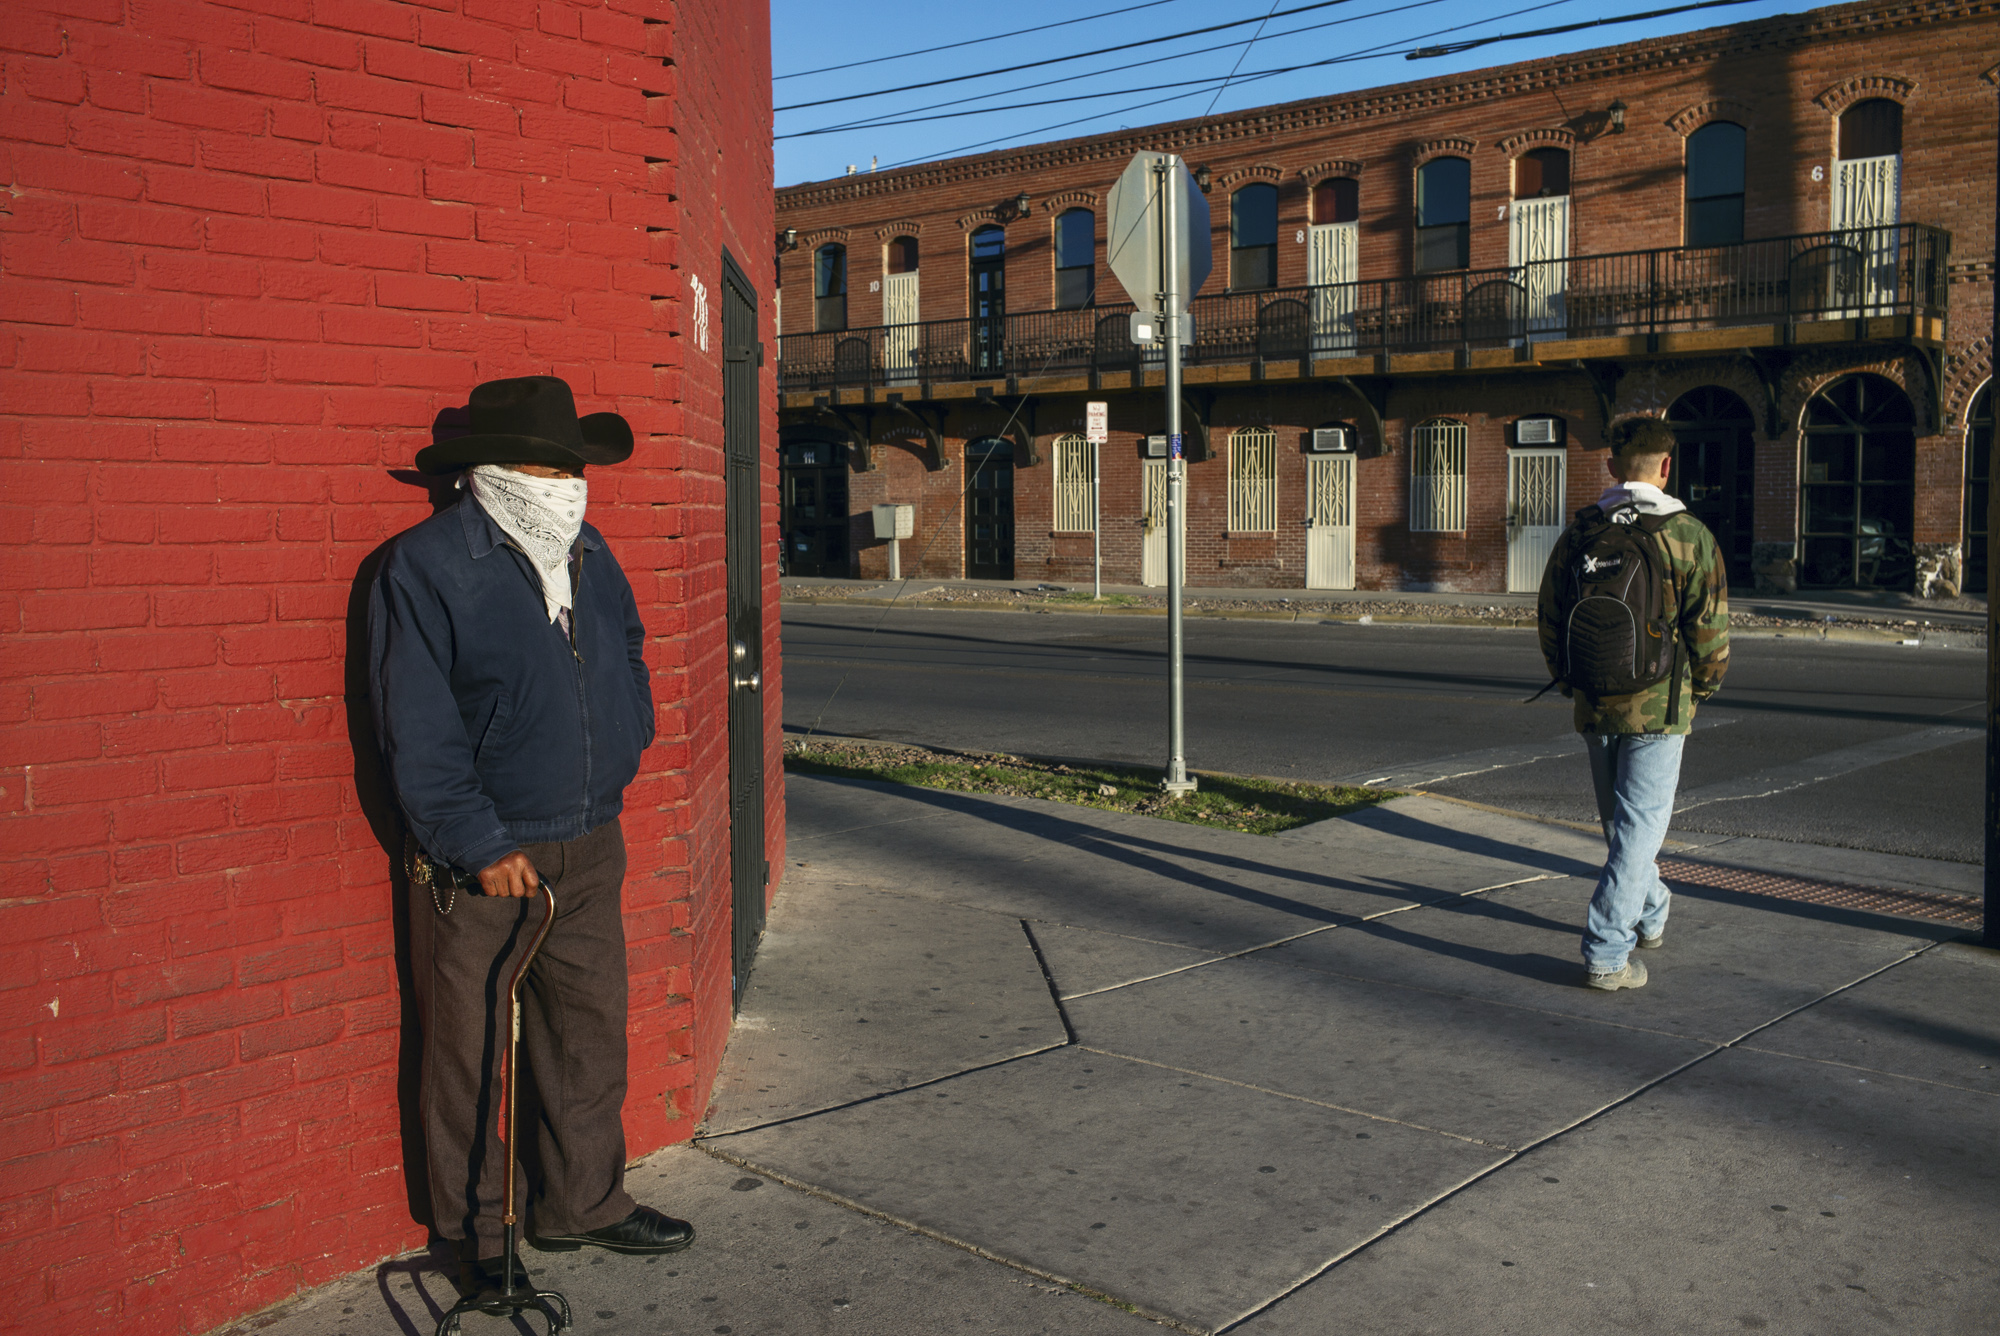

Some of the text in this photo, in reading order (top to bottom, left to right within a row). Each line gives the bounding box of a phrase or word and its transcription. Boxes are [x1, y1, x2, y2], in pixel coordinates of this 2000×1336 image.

[1811, 165, 1824, 182] 6
[1497, 205, 1507, 221] 7
[1296, 229, 1304, 244] 8
[869, 280, 880, 293] 10
